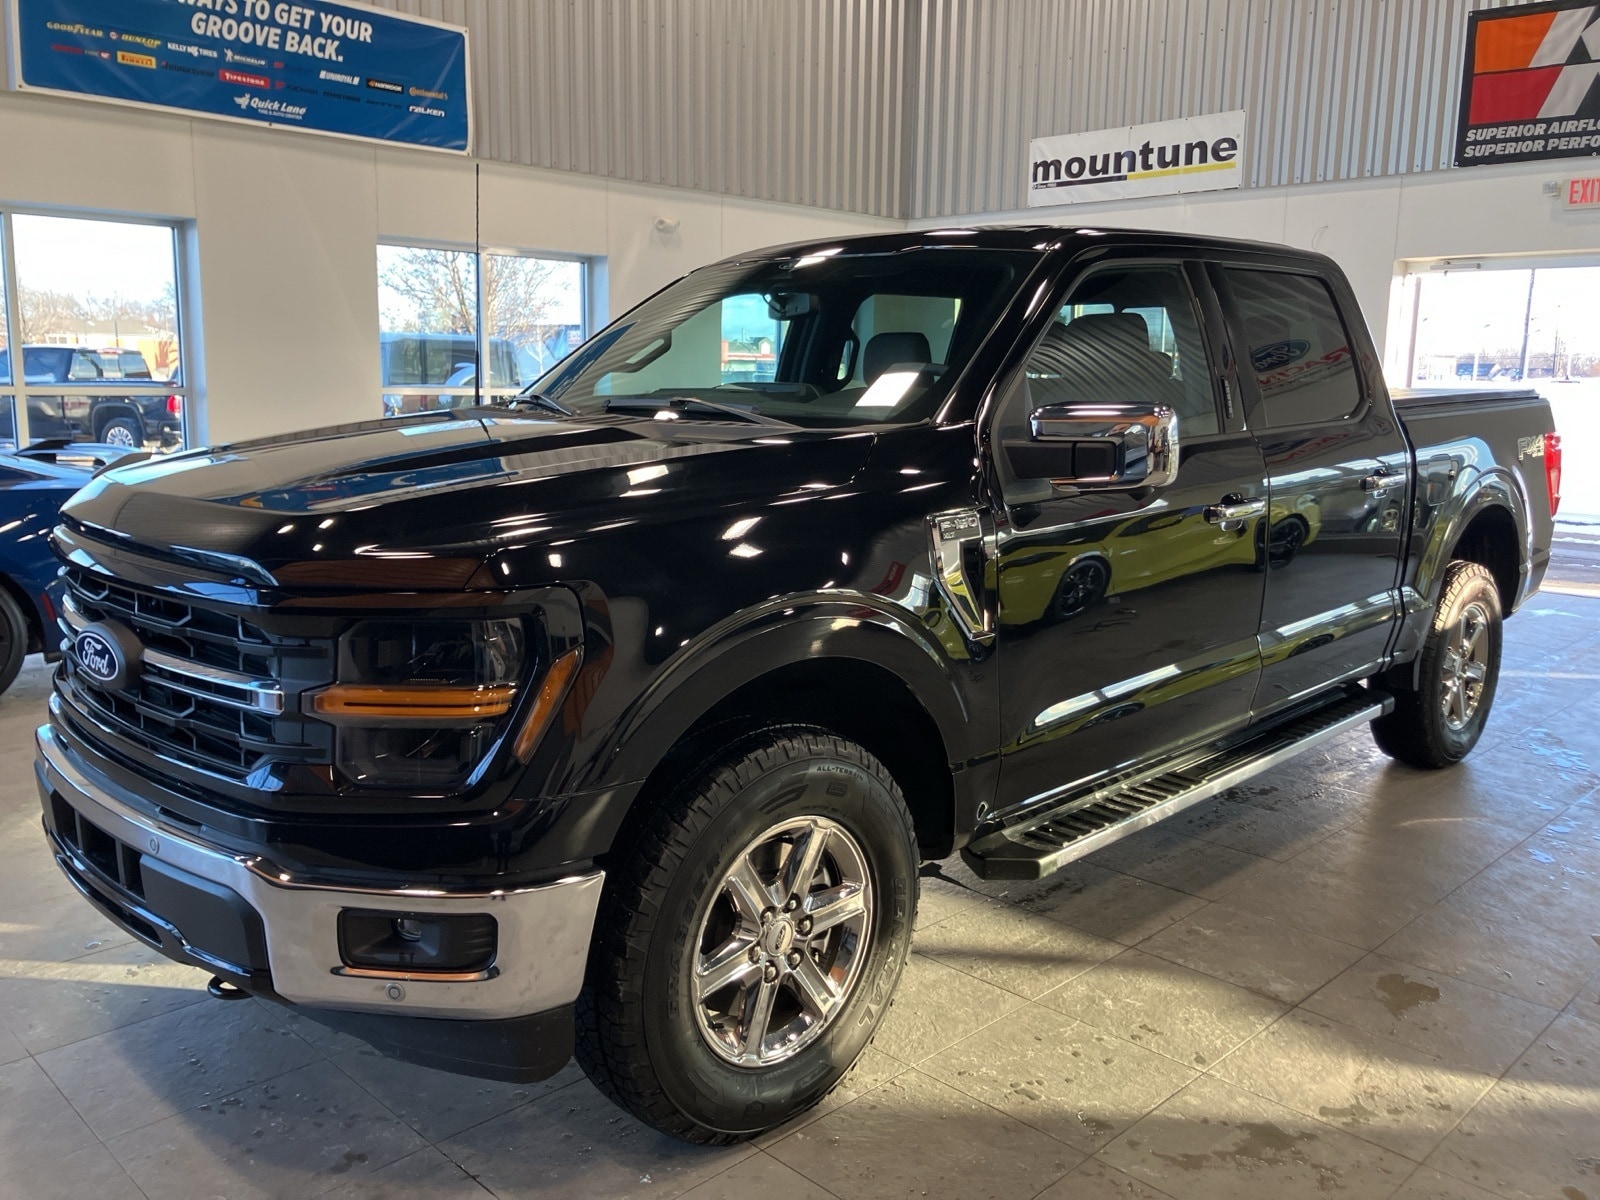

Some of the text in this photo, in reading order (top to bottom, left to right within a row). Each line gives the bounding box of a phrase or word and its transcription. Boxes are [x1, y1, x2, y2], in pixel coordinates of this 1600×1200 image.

[46, 21, 103, 38] GOODYEAR
[243, 0, 270, 20] TO
[274, 2, 315, 30] GET
[320, 12, 373, 43] YOUR
[121, 34, 161, 46] DUNLOP
[191, 11, 343, 62] GROOVE BACK.
[167, 42, 218, 58] KELLY TIRES
[250, 97, 308, 115] Quick Lane
[1465, 119, 1600, 142] SUPERIOR AIRFL
[1463, 139, 1546, 157] SUPERIOR
[1032, 136, 1238, 183] mountune
[82, 637, 109, 676] Ford
